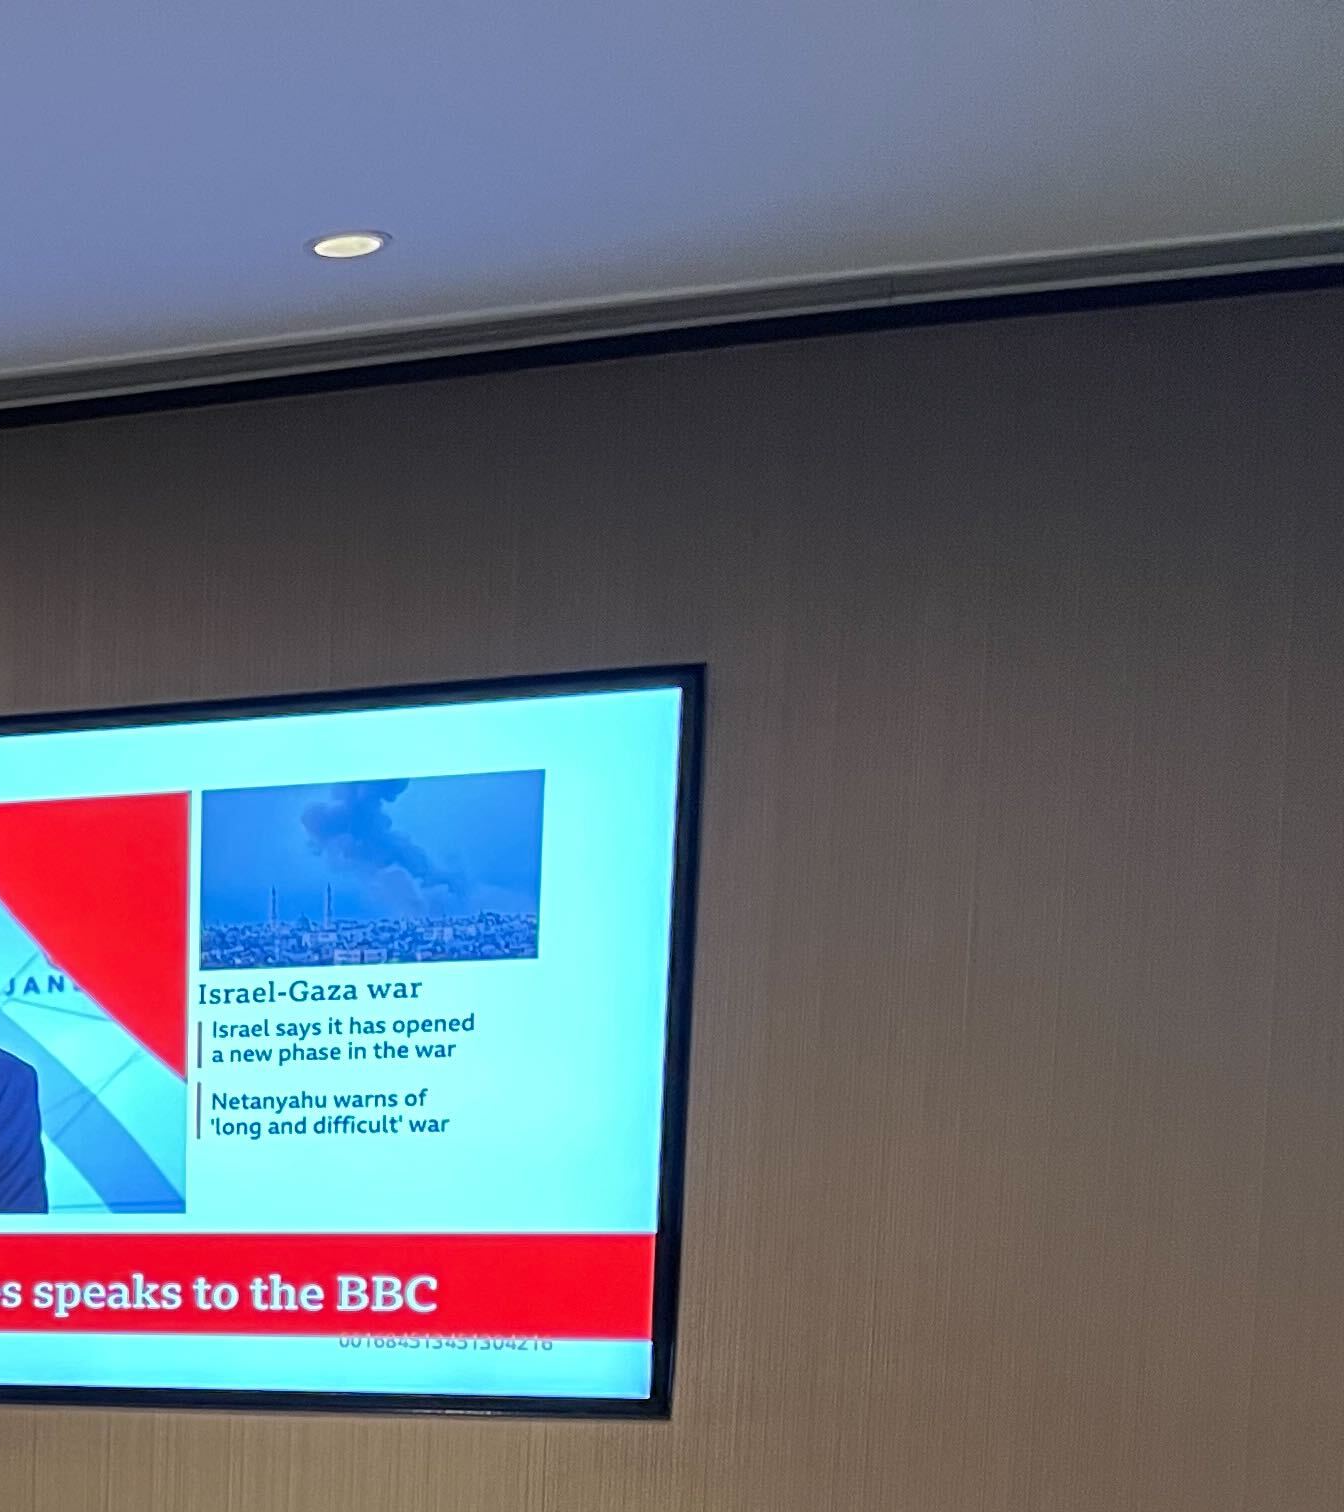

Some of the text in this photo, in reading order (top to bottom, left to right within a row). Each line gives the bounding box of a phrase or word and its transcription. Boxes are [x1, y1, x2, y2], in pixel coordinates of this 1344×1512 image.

[4, 975, 81, 997] JAN
[198, 980, 423, 1005] Israel-Gaza war
[212, 1013, 475, 1040] Israel says it has opened
[212, 1041, 457, 1066] a new phase in the war
[212, 1088, 428, 1114] Netanyahu warns of
[211, 1115, 450, 1140] 'long and difficult' war
[33, 1273, 182, 1318] speaks
[193, 1276, 239, 1311] to
[250, 1274, 324, 1311] the
[336, 1275, 438, 1313] BBC
